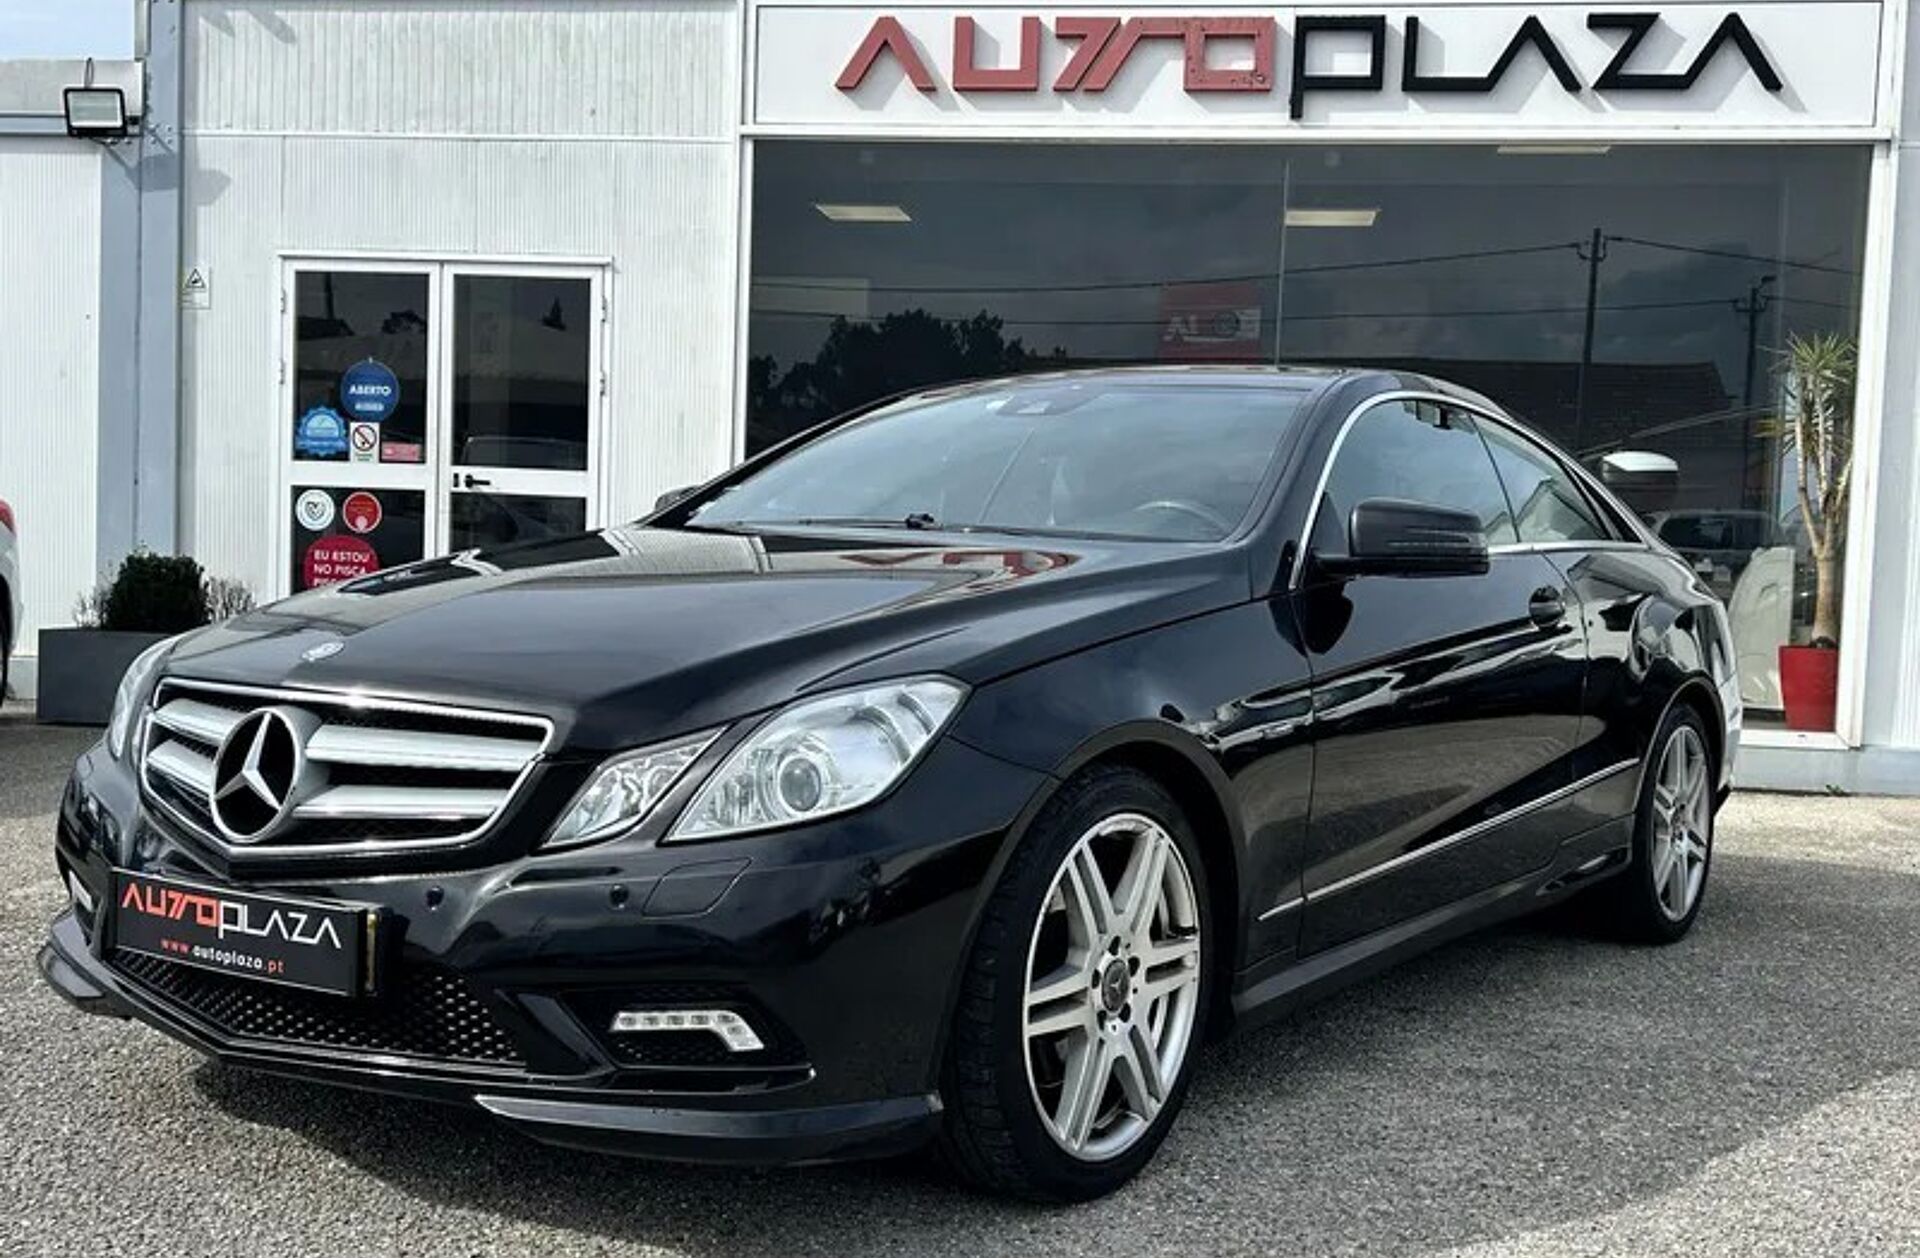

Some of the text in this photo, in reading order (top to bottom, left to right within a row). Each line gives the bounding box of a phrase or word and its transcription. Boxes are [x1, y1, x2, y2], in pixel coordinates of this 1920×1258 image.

[349, 384, 392, 397] ABERTO
[313, 550, 370, 563] EU ESTOU
[313, 563, 332, 575] NO
